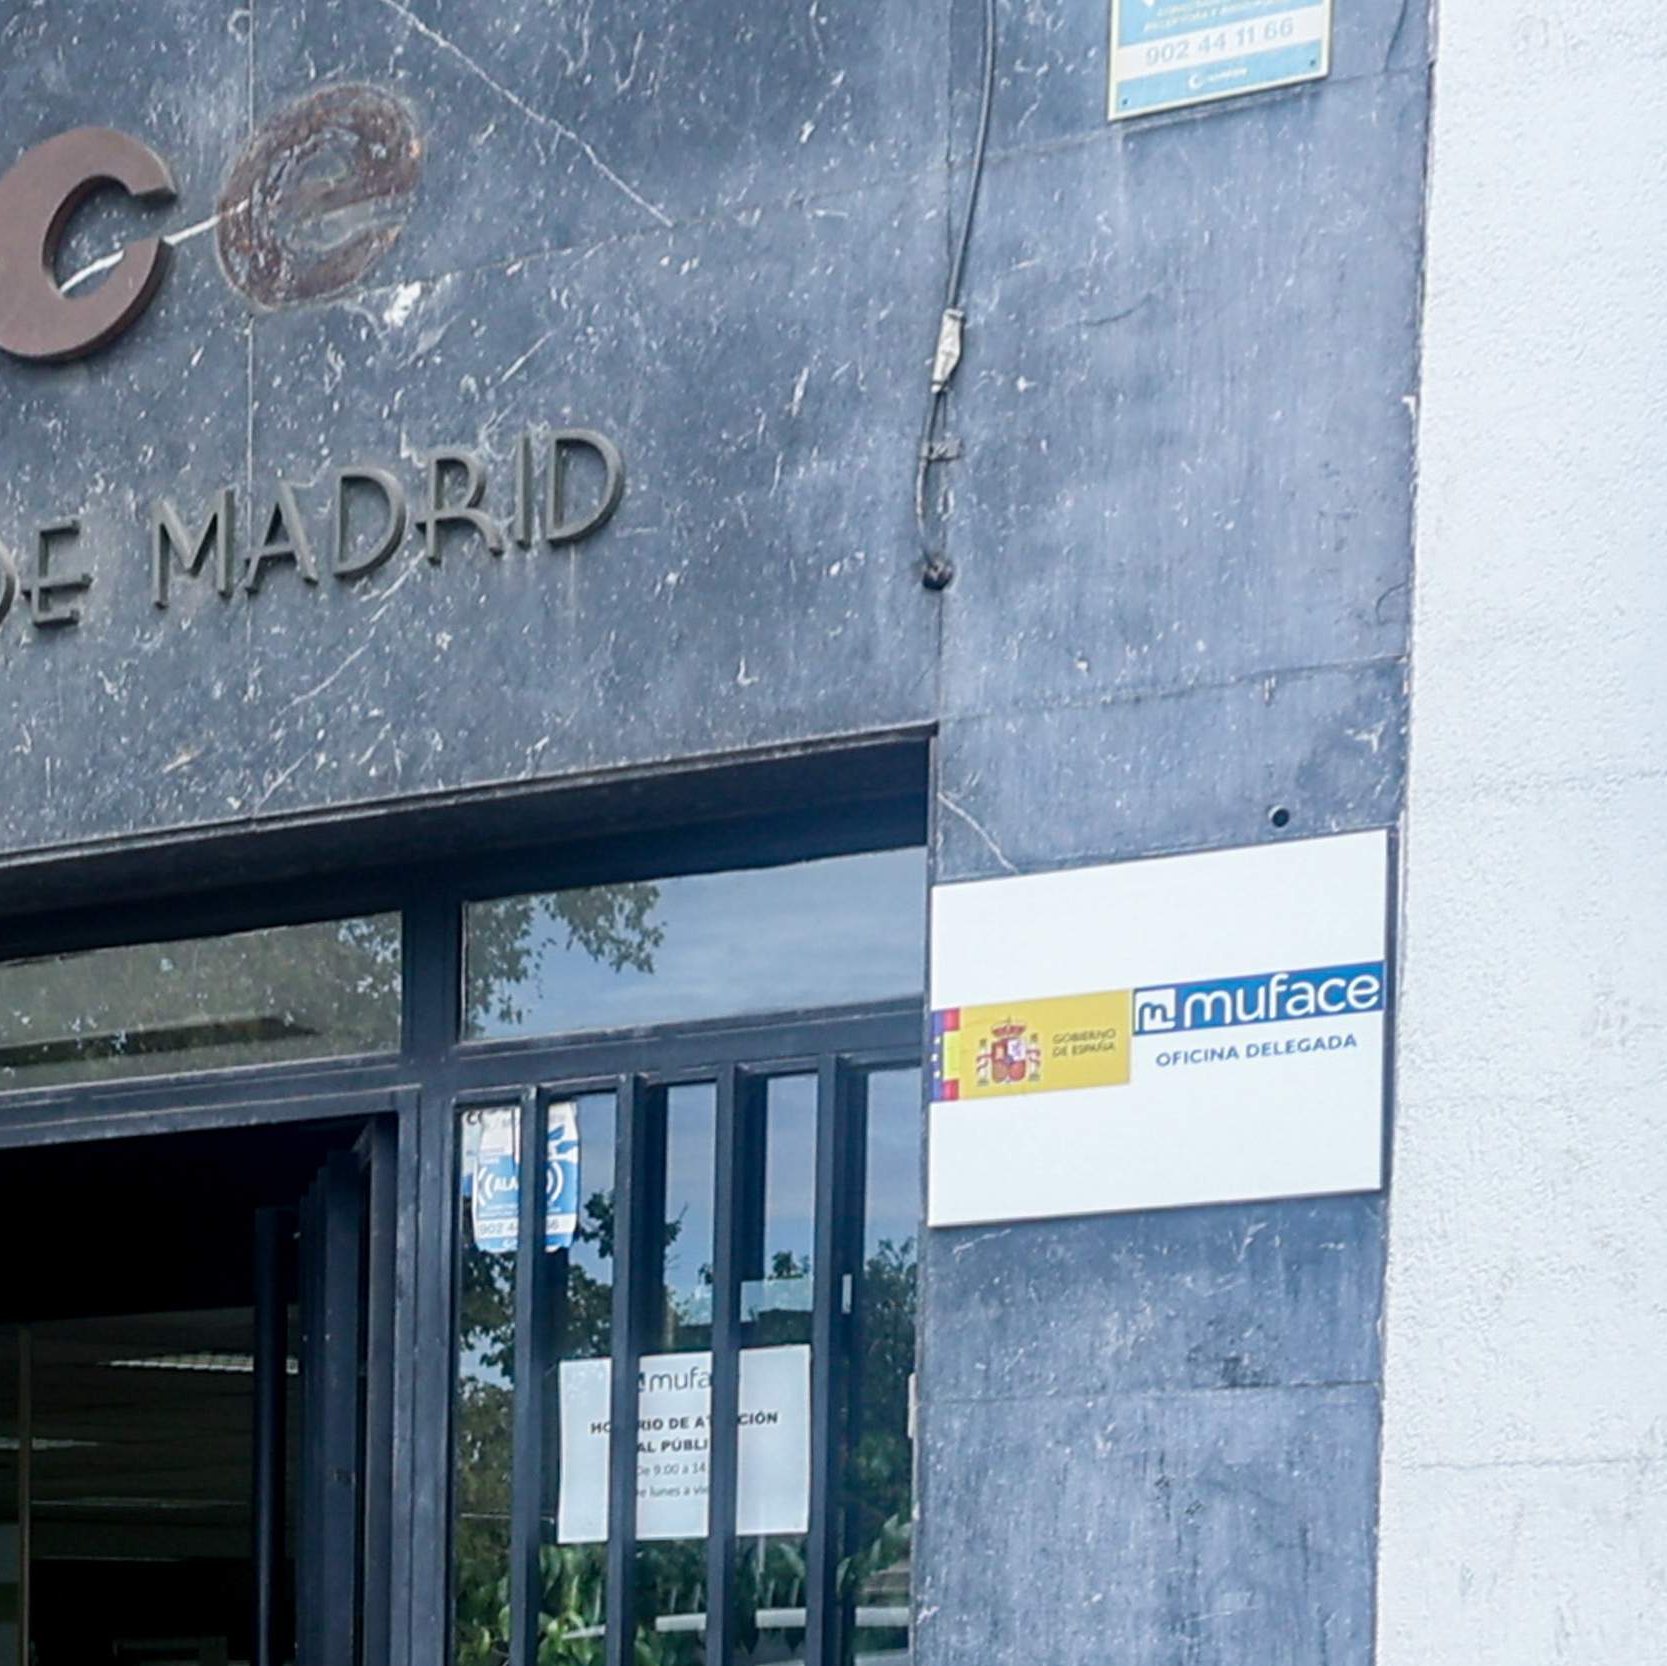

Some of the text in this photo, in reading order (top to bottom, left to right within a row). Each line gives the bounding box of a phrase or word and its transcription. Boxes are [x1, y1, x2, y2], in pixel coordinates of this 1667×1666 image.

[150, 427, 627, 610] MADRID
[1183, 970, 1381, 1028] muface
[1154, 1032, 1358, 1068] OFICINA DELEGADA
[649, 1366, 711, 1393] mufa
[668, 1416, 689, 1430] DE
